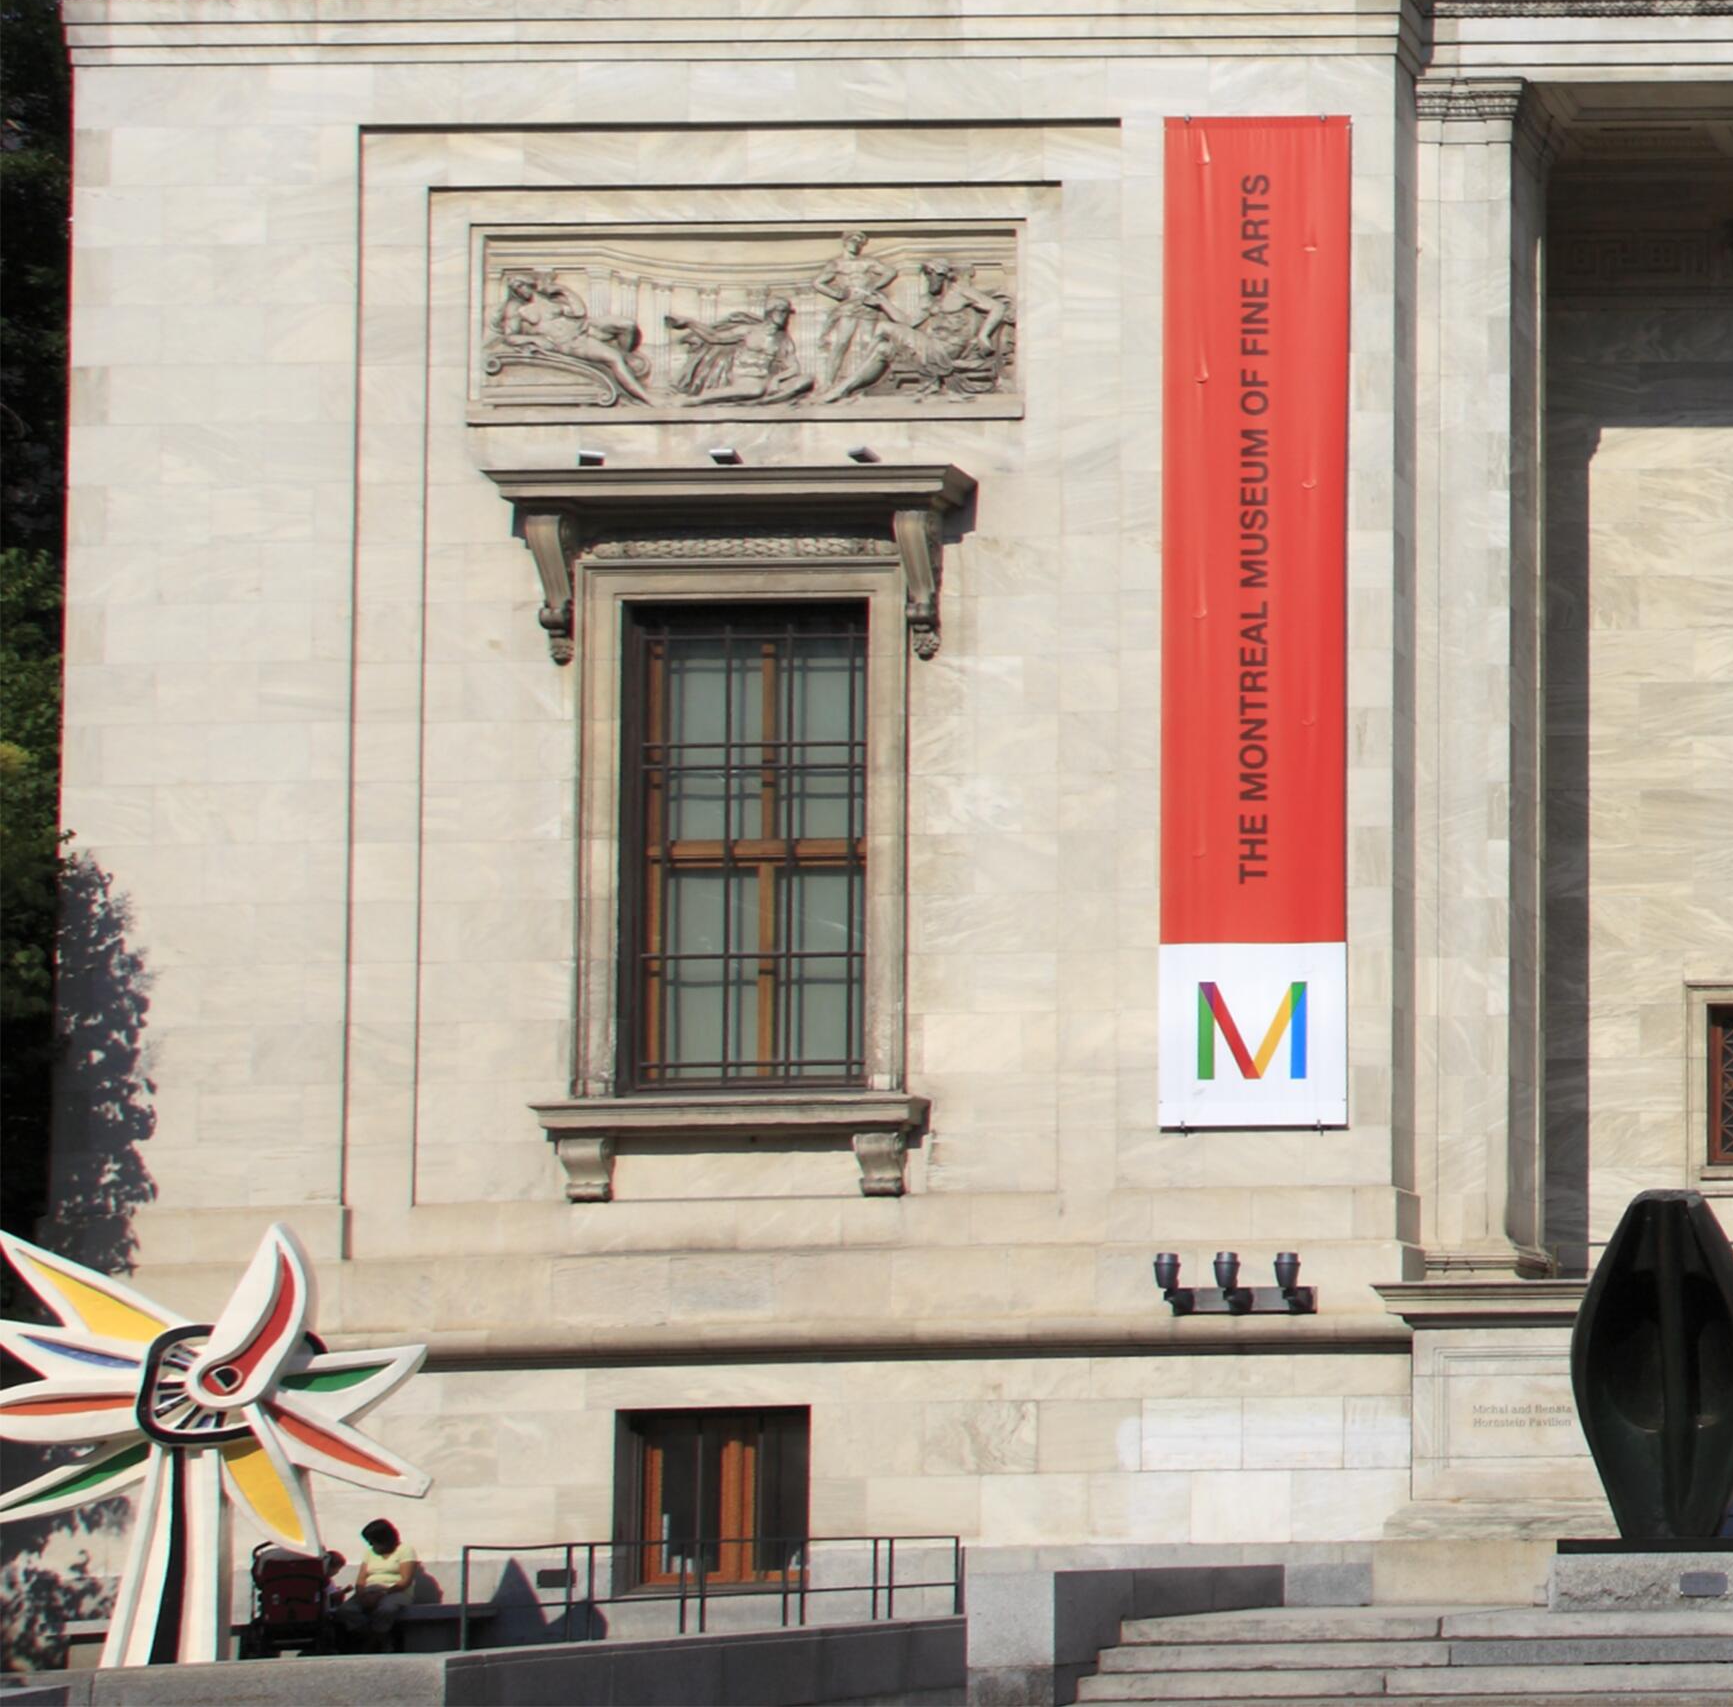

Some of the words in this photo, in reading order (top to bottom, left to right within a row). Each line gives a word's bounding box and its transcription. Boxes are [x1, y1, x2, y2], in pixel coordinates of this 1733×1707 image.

[1240, 173, 1272, 267] ARTS
[1240, 279, 1271, 357] FINE
[1239, 369, 1271, 416] OF
[1239, 429, 1271, 589] MUSEUM
[1238, 601, 1270, 802] MONTREAL
[1238, 814, 1270, 886] THE
[1198, 982, 1308, 1081] M
[1472, 1403, 1508, 1414] Michal
[1511, 1403, 1531, 1414] and
